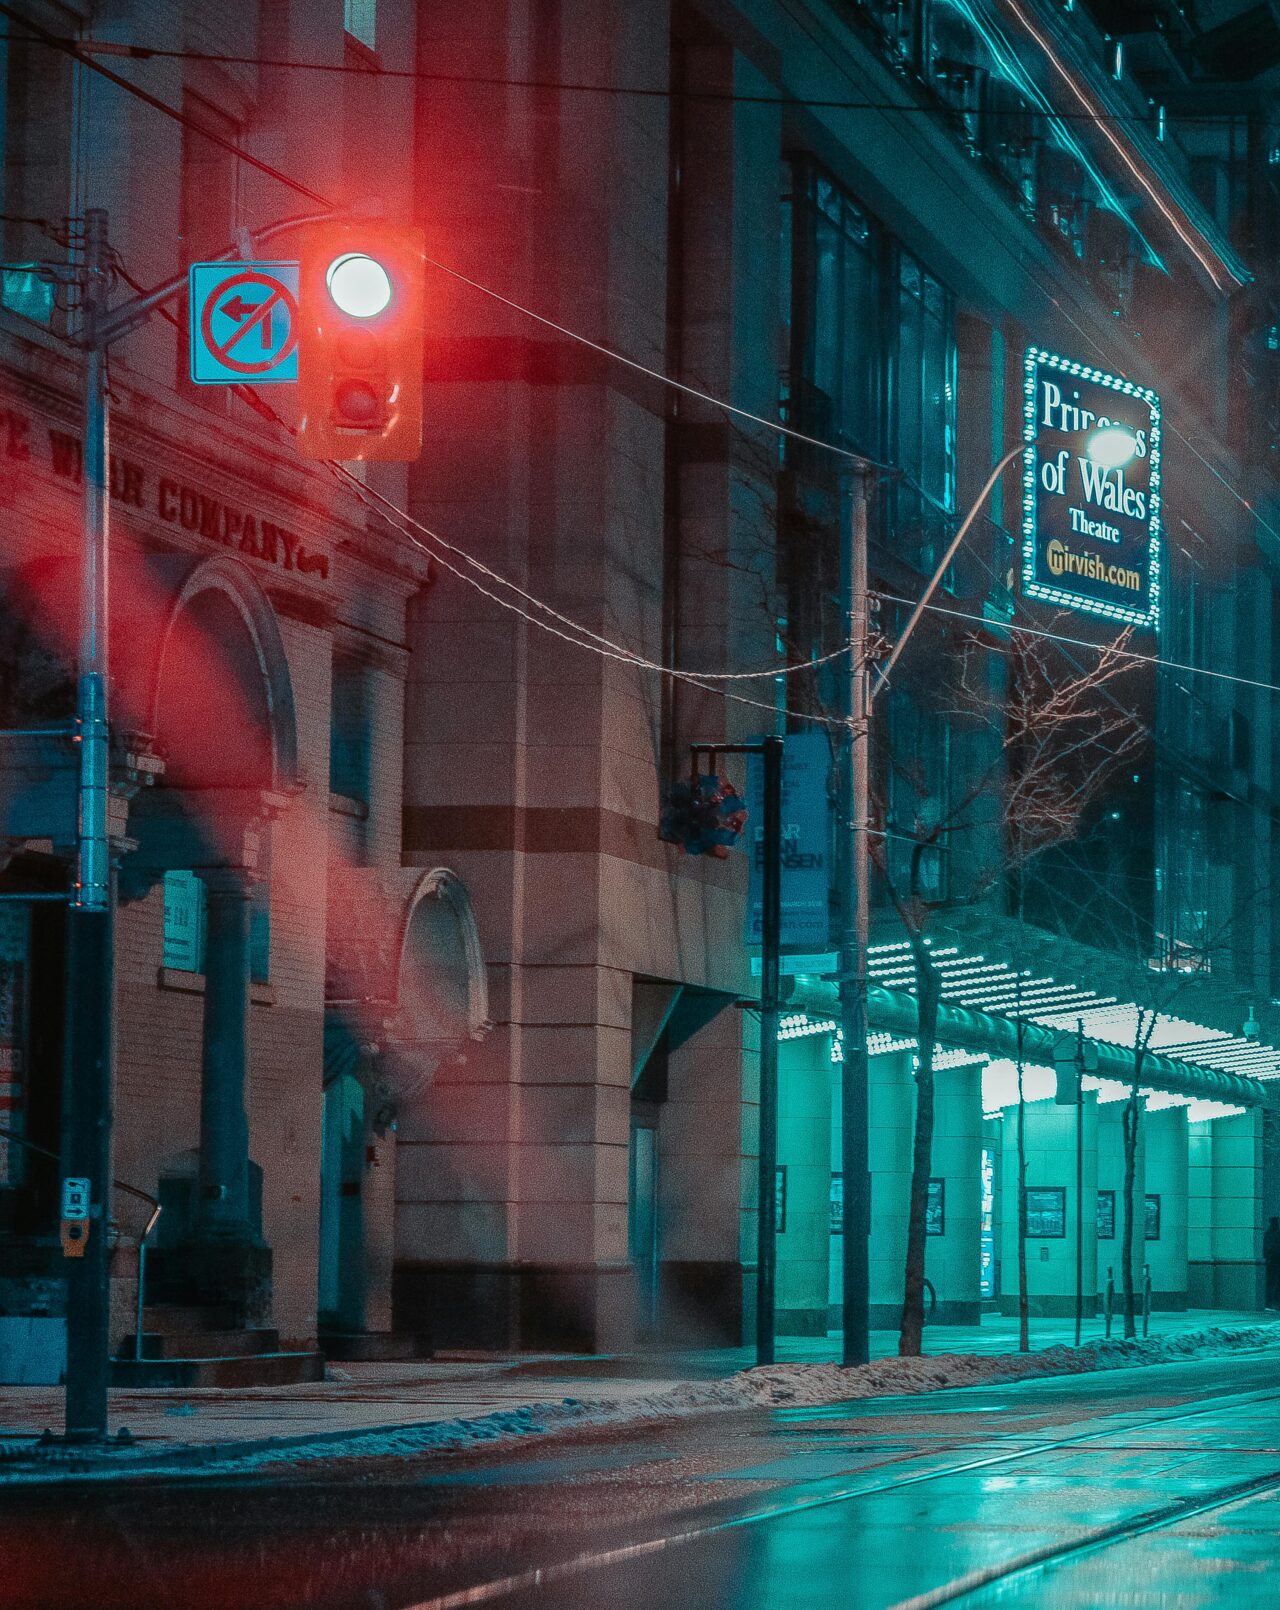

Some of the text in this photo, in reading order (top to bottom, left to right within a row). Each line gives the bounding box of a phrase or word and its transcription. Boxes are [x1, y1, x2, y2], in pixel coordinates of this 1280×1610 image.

[1042, 381, 1146, 457] Prins
[1042, 451, 1146, 520] of Wales
[159, 478, 300, 570] COMPANY
[1069, 508, 1120, 543] Theatre
